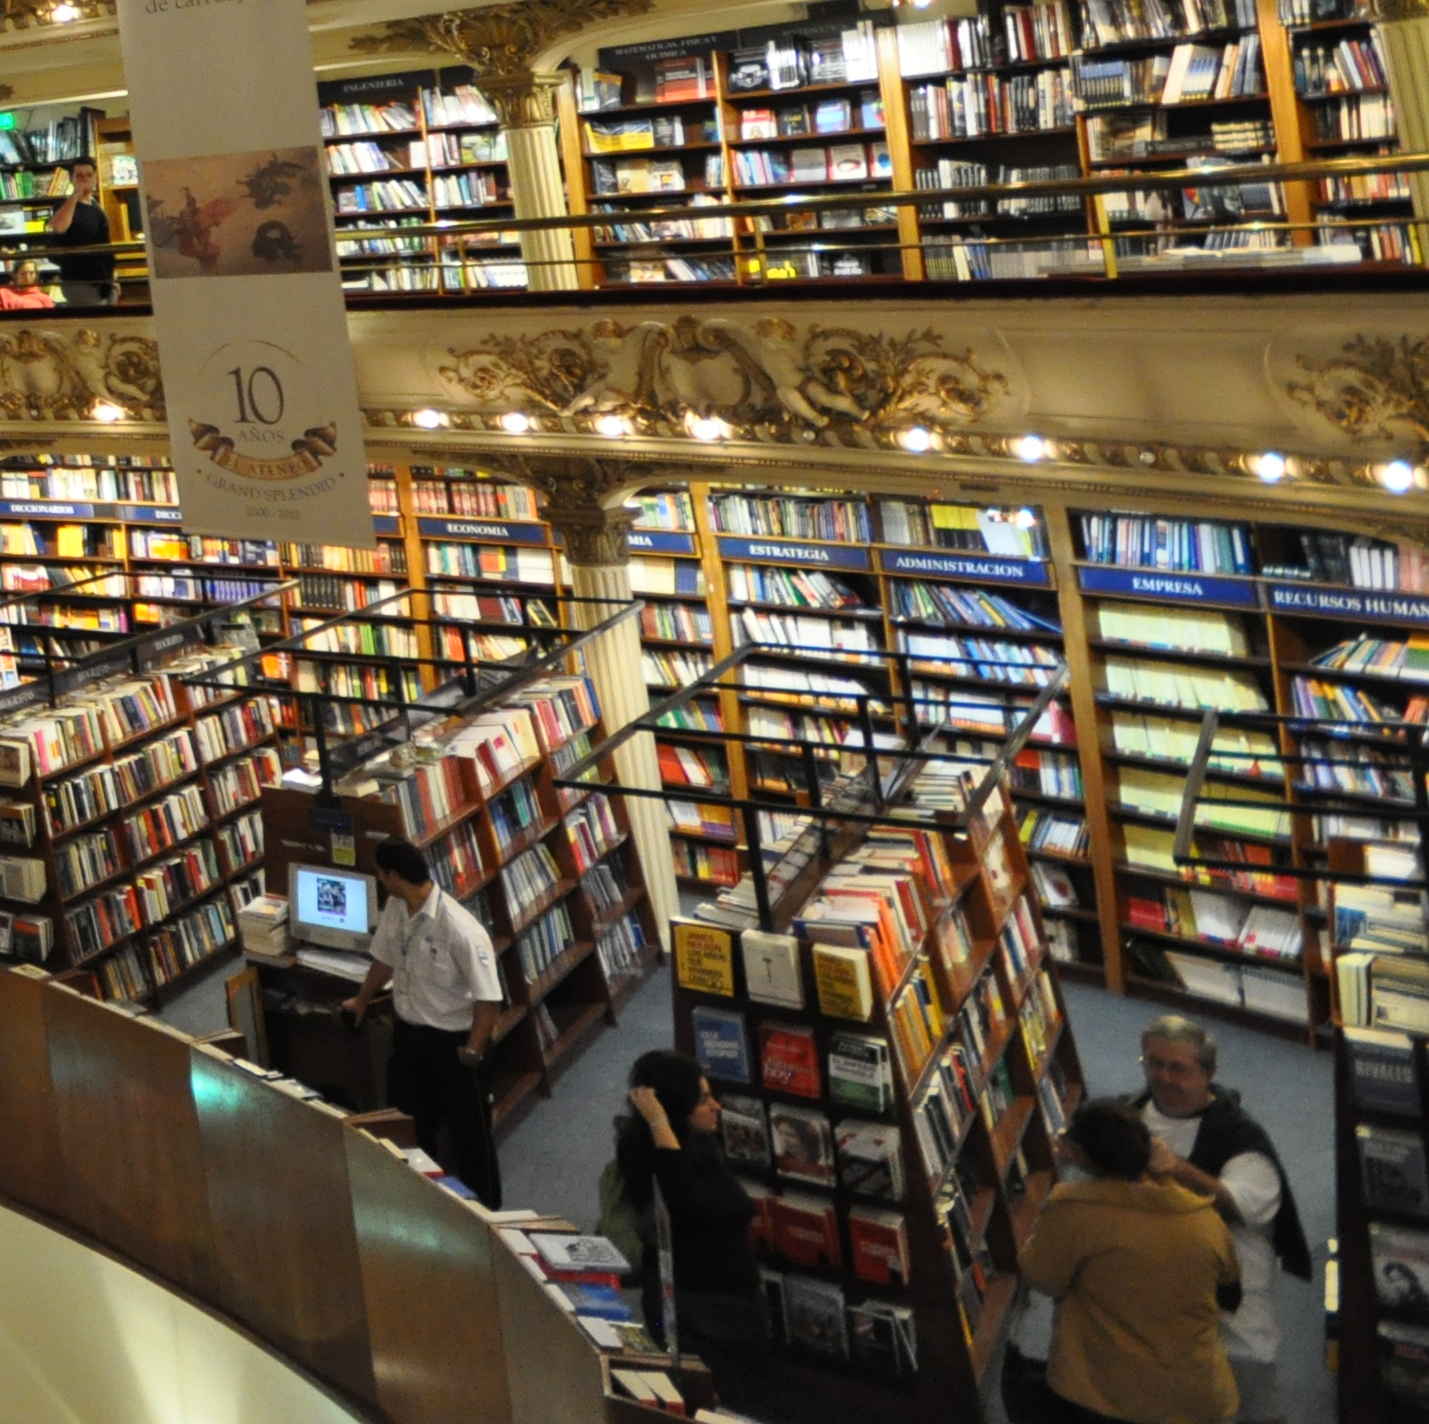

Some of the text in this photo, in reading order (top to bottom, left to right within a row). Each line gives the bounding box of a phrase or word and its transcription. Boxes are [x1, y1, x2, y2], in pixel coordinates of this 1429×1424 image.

[343, 78, 405, 93] INGENIERIA
[227, 366, 284, 425] 10
[241, 426, 285, 444] AÑOS
[207, 475, 336, 501] GRAND SPLENDID
[10, 503, 75, 515] DICCIONARIOS
[447, 523, 509, 537] ECONOMIA
[749, 544, 830, 562] ESTRATEGIA
[896, 557, 1024, 577] ADMINISTRACION
[1132, 577, 1203, 596] EMPRESA
[1274, 590, 1362, 612] RECURSOS
